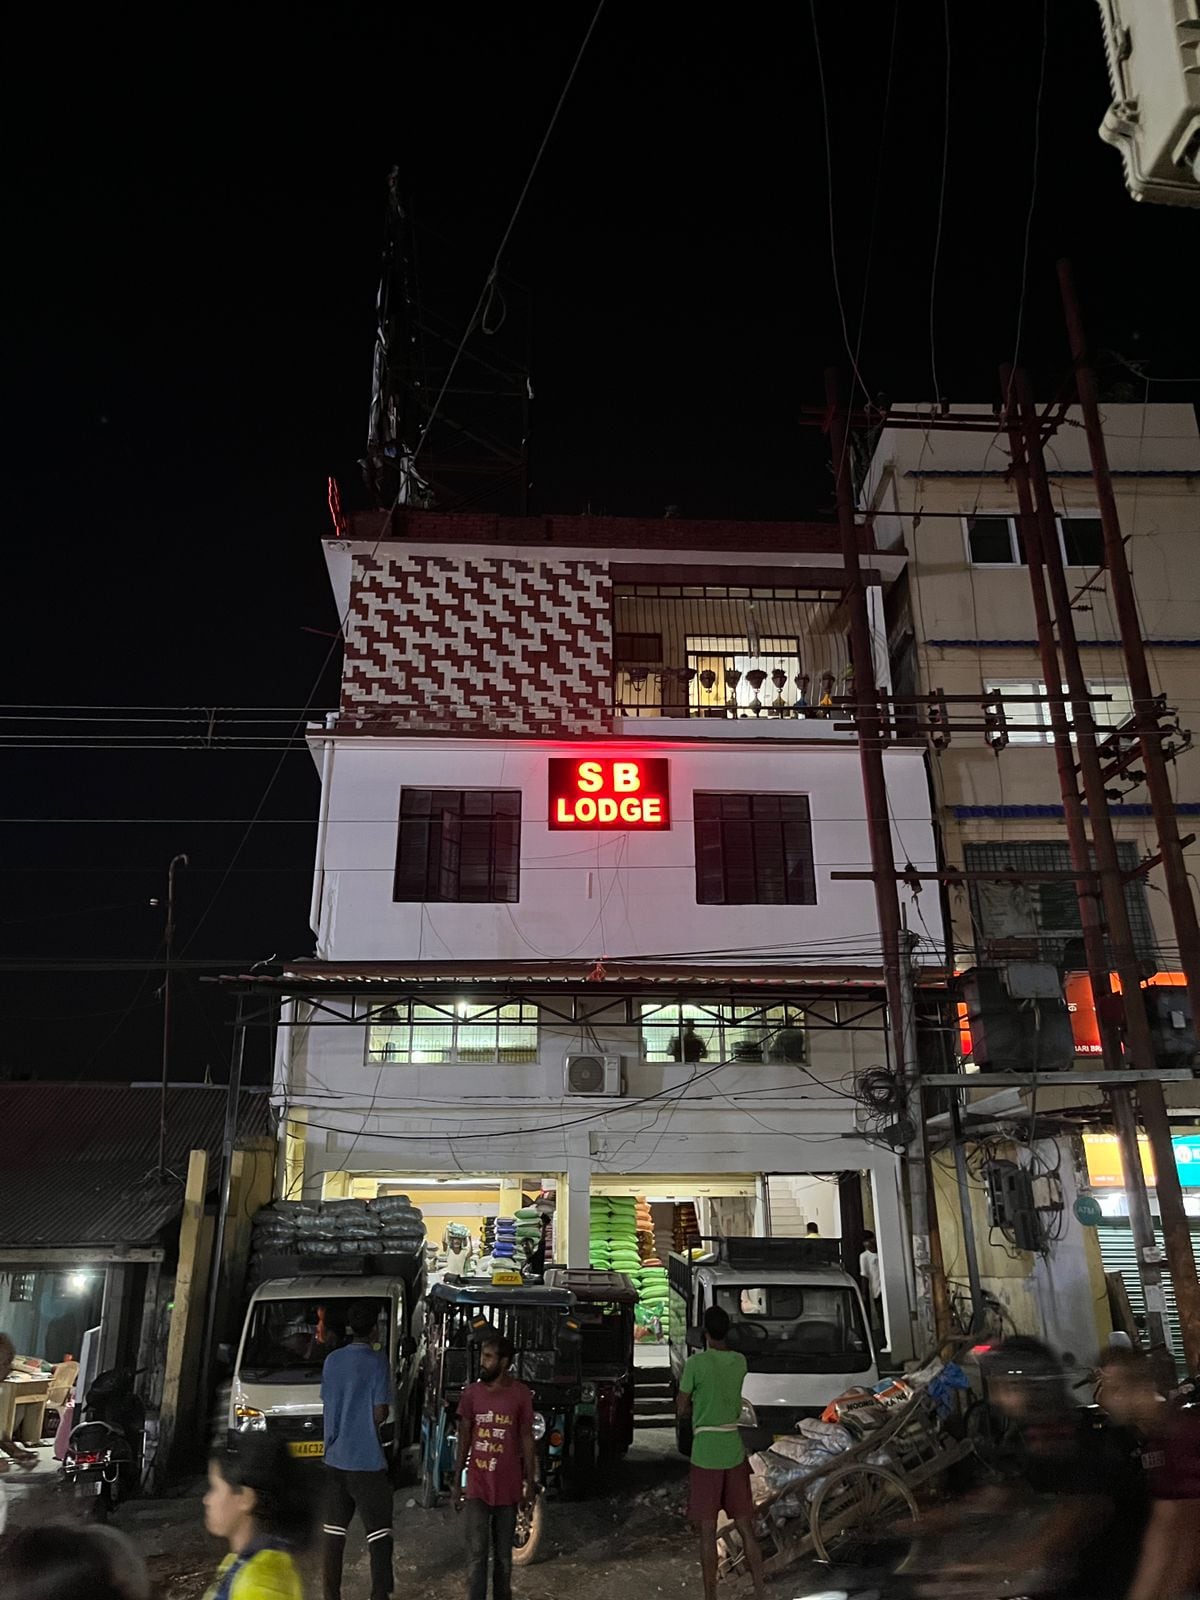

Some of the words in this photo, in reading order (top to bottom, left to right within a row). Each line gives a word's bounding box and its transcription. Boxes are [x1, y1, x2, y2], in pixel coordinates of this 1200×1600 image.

[577, 762, 603, 792] S
[613, 762, 640, 792] B
[557, 797, 661, 822] LODGE
[1078, 1206, 1094, 1215] ATM
